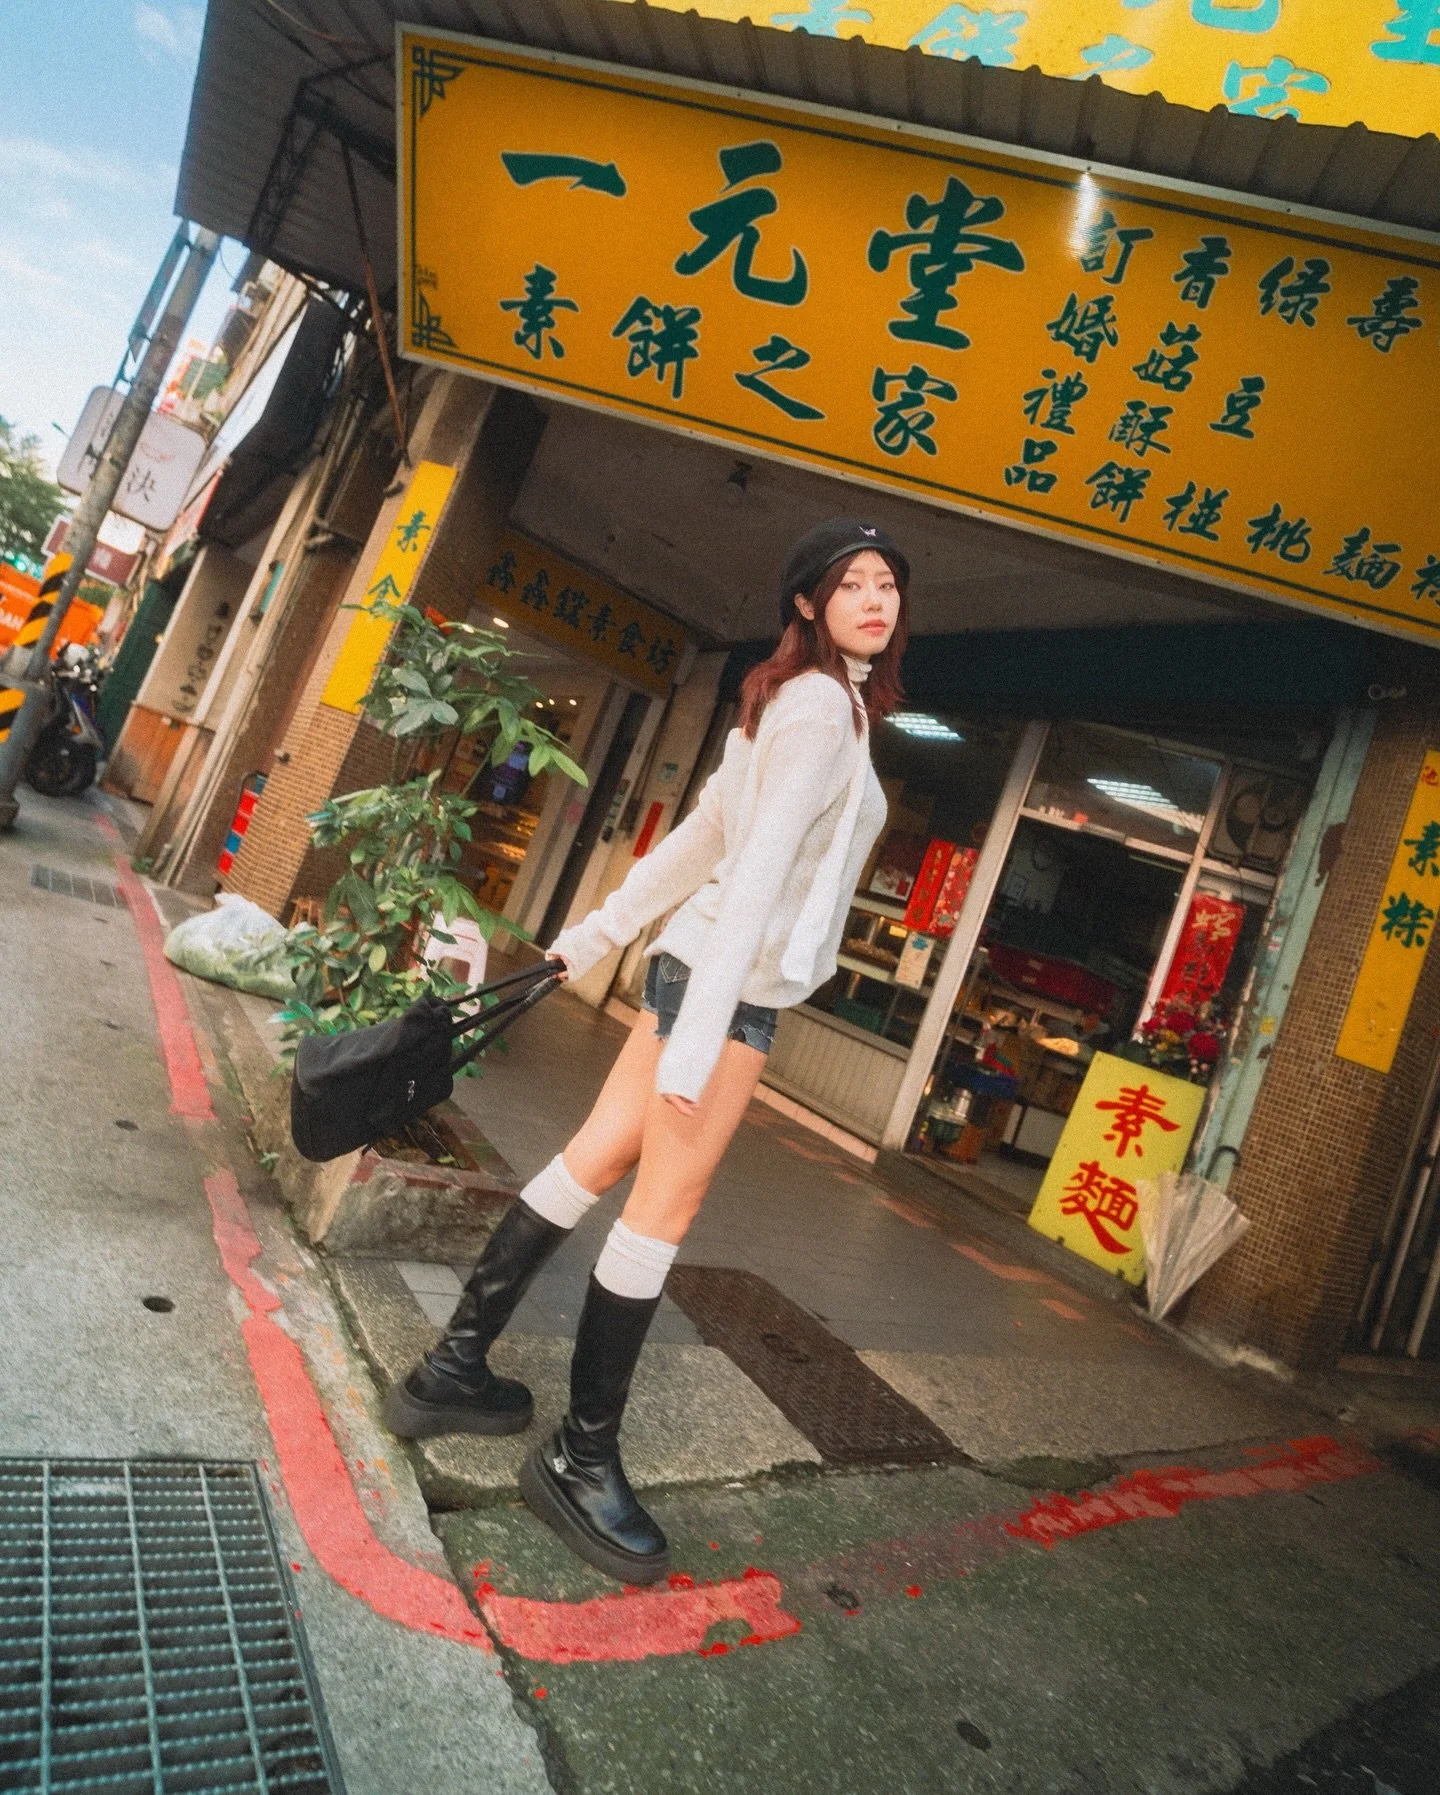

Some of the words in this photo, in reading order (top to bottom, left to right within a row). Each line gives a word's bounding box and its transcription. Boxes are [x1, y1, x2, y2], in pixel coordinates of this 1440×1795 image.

[501, 140, 1026, 351] 一元堂
[500, 263, 959, 457] 素餅之家
[1004, 210, 1154, 494] 訂婚禮品
[1085, 236, 1233, 524] 香菇酥餅
[1059, 1084, 1182, 1255] 素麵
